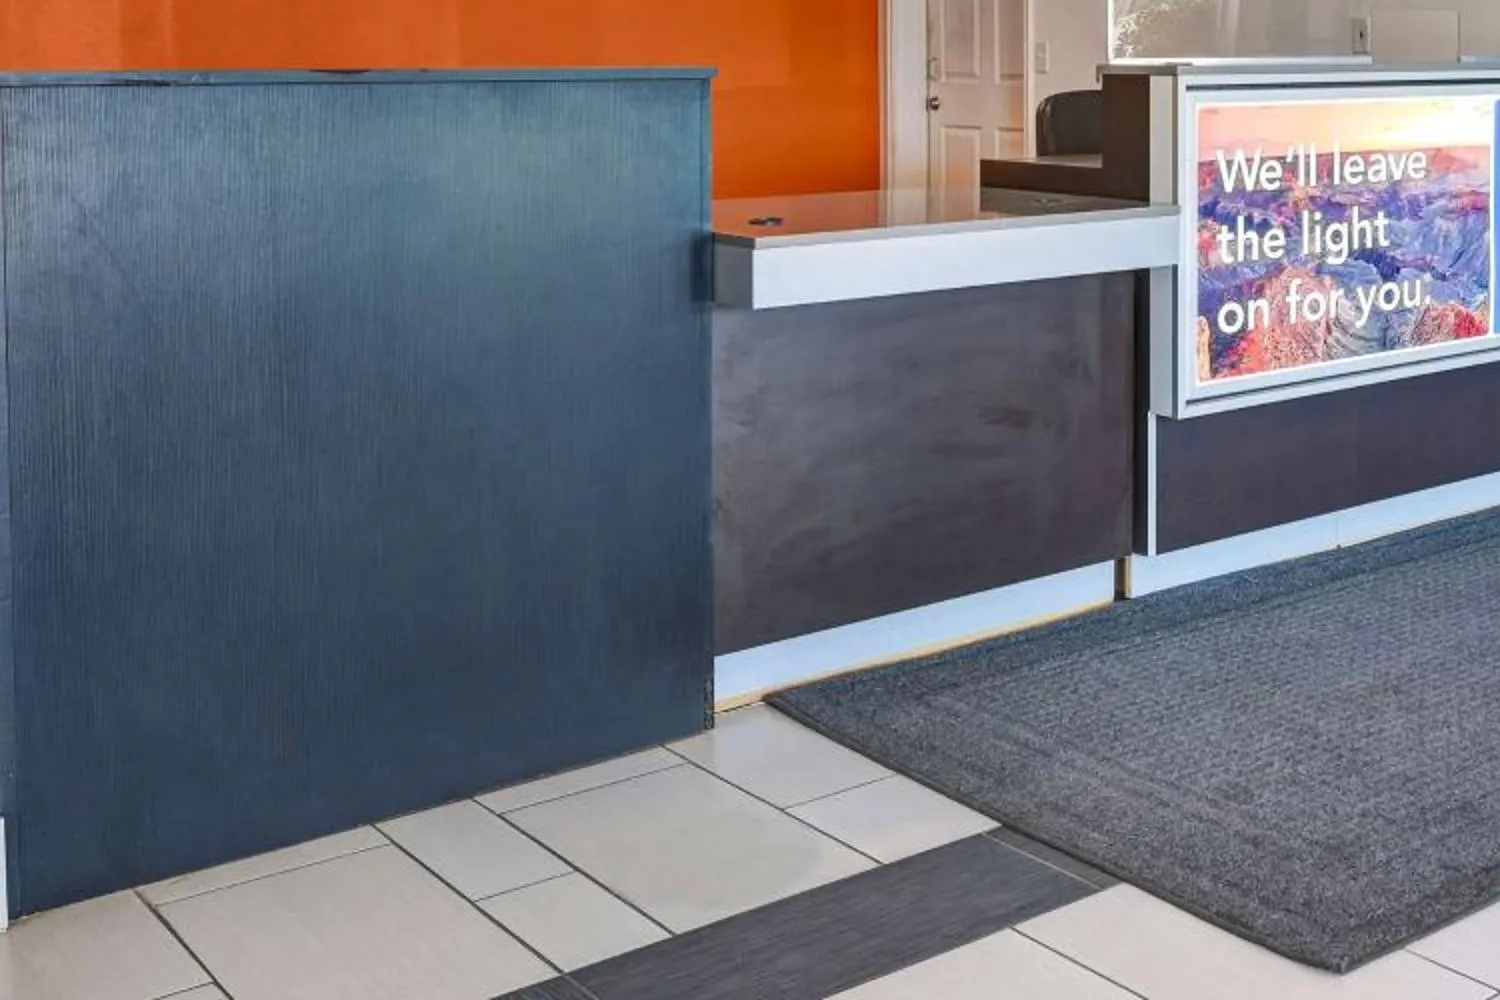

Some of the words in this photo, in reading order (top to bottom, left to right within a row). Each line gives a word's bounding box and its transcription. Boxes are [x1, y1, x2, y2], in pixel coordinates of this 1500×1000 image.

[1216, 142, 1317, 193] We'll
[1333, 139, 1427, 185] leave
[1216, 214, 1286, 264] the
[1302, 206, 1391, 265] light
[1217, 298, 1271, 334] on
[1286, 278, 1345, 324] for
[1355, 279, 1431, 329] you.
